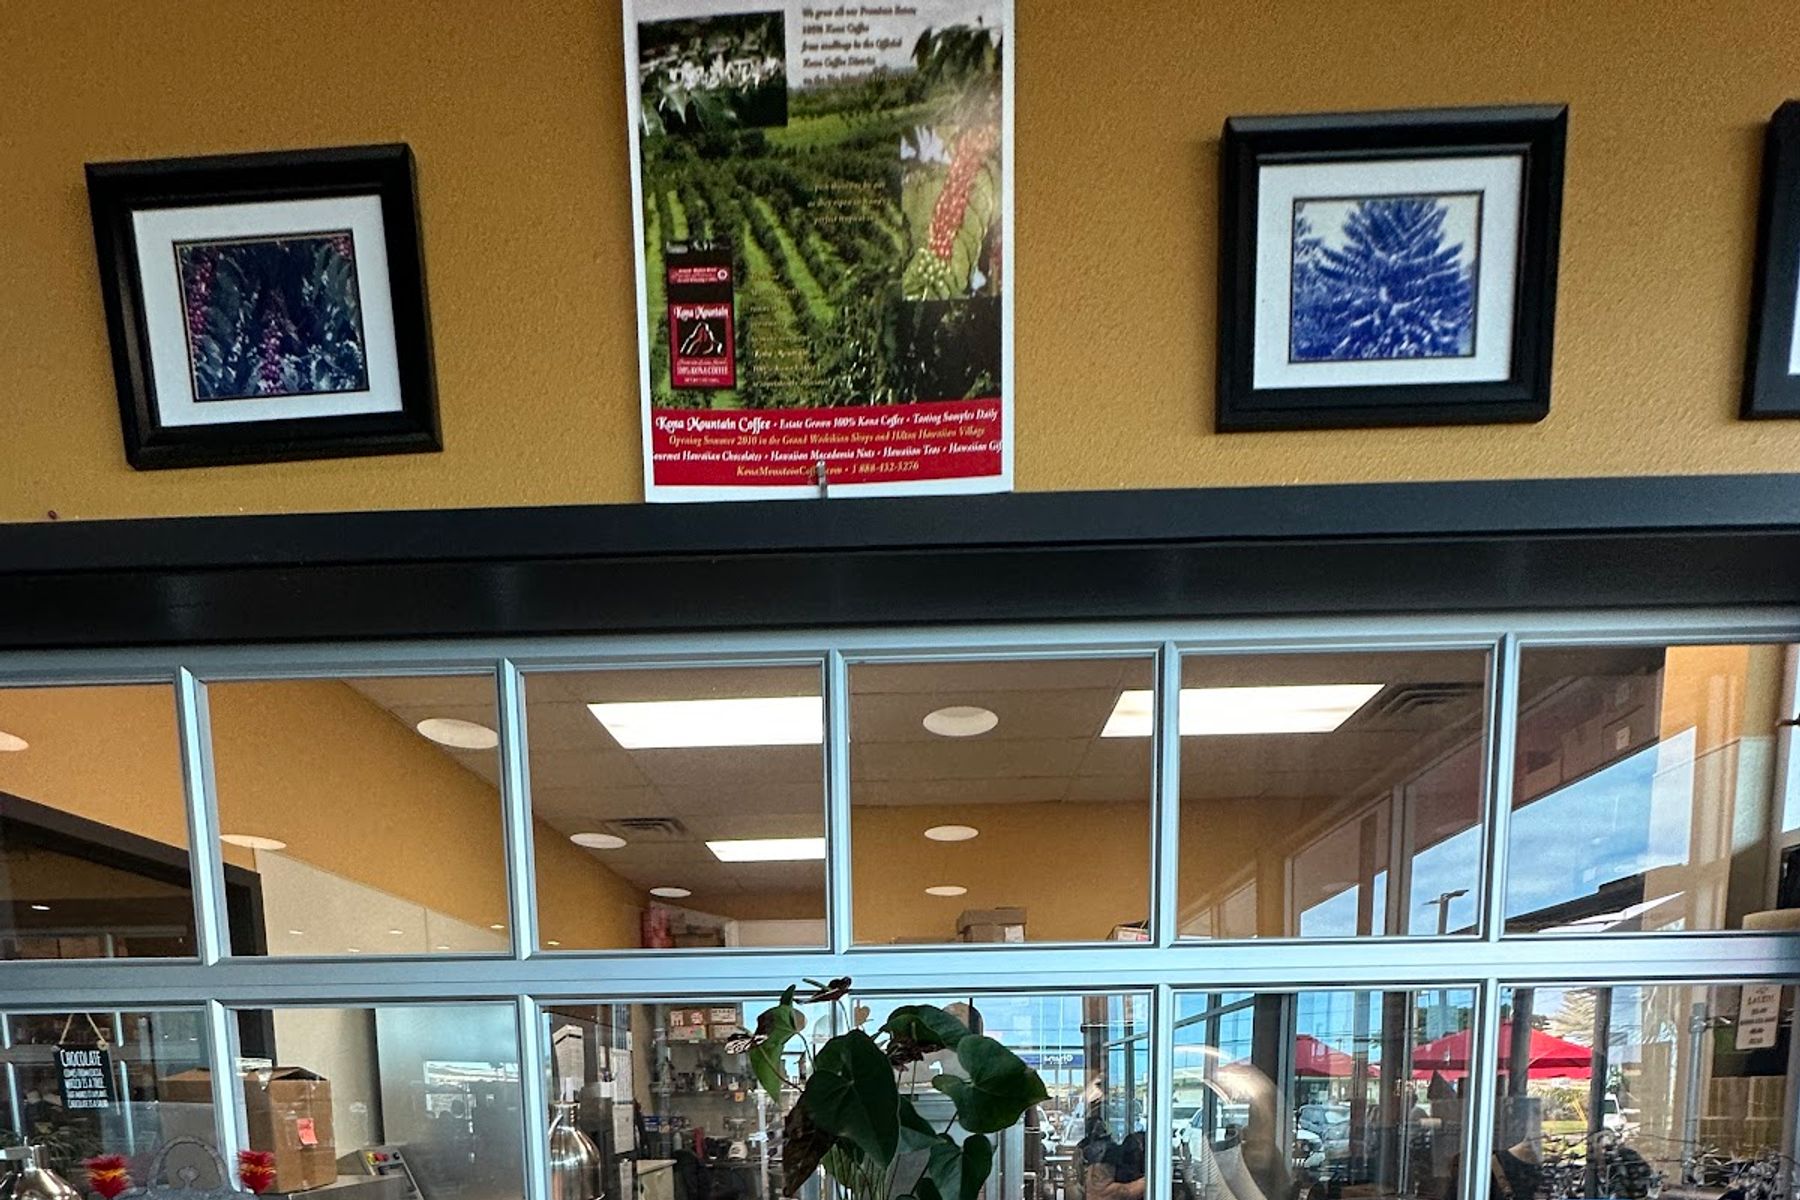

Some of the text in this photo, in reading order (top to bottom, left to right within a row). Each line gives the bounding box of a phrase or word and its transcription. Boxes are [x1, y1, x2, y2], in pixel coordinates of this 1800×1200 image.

[655, 416, 685, 434] Kona
[686, 416, 736, 432] Mountain
[738, 416, 771, 434] Coffee
[857, 415, 878, 427] Kona
[880, 414, 904, 429] Coffee
[652, 451, 681, 461] ourmet
[682, 450, 721, 461] Hawaiian
[770, 449, 809, 461] Hawaiian
[883, 446, 921, 458] Hawaiian
[948, 442, 987, 454] Hawaiian
